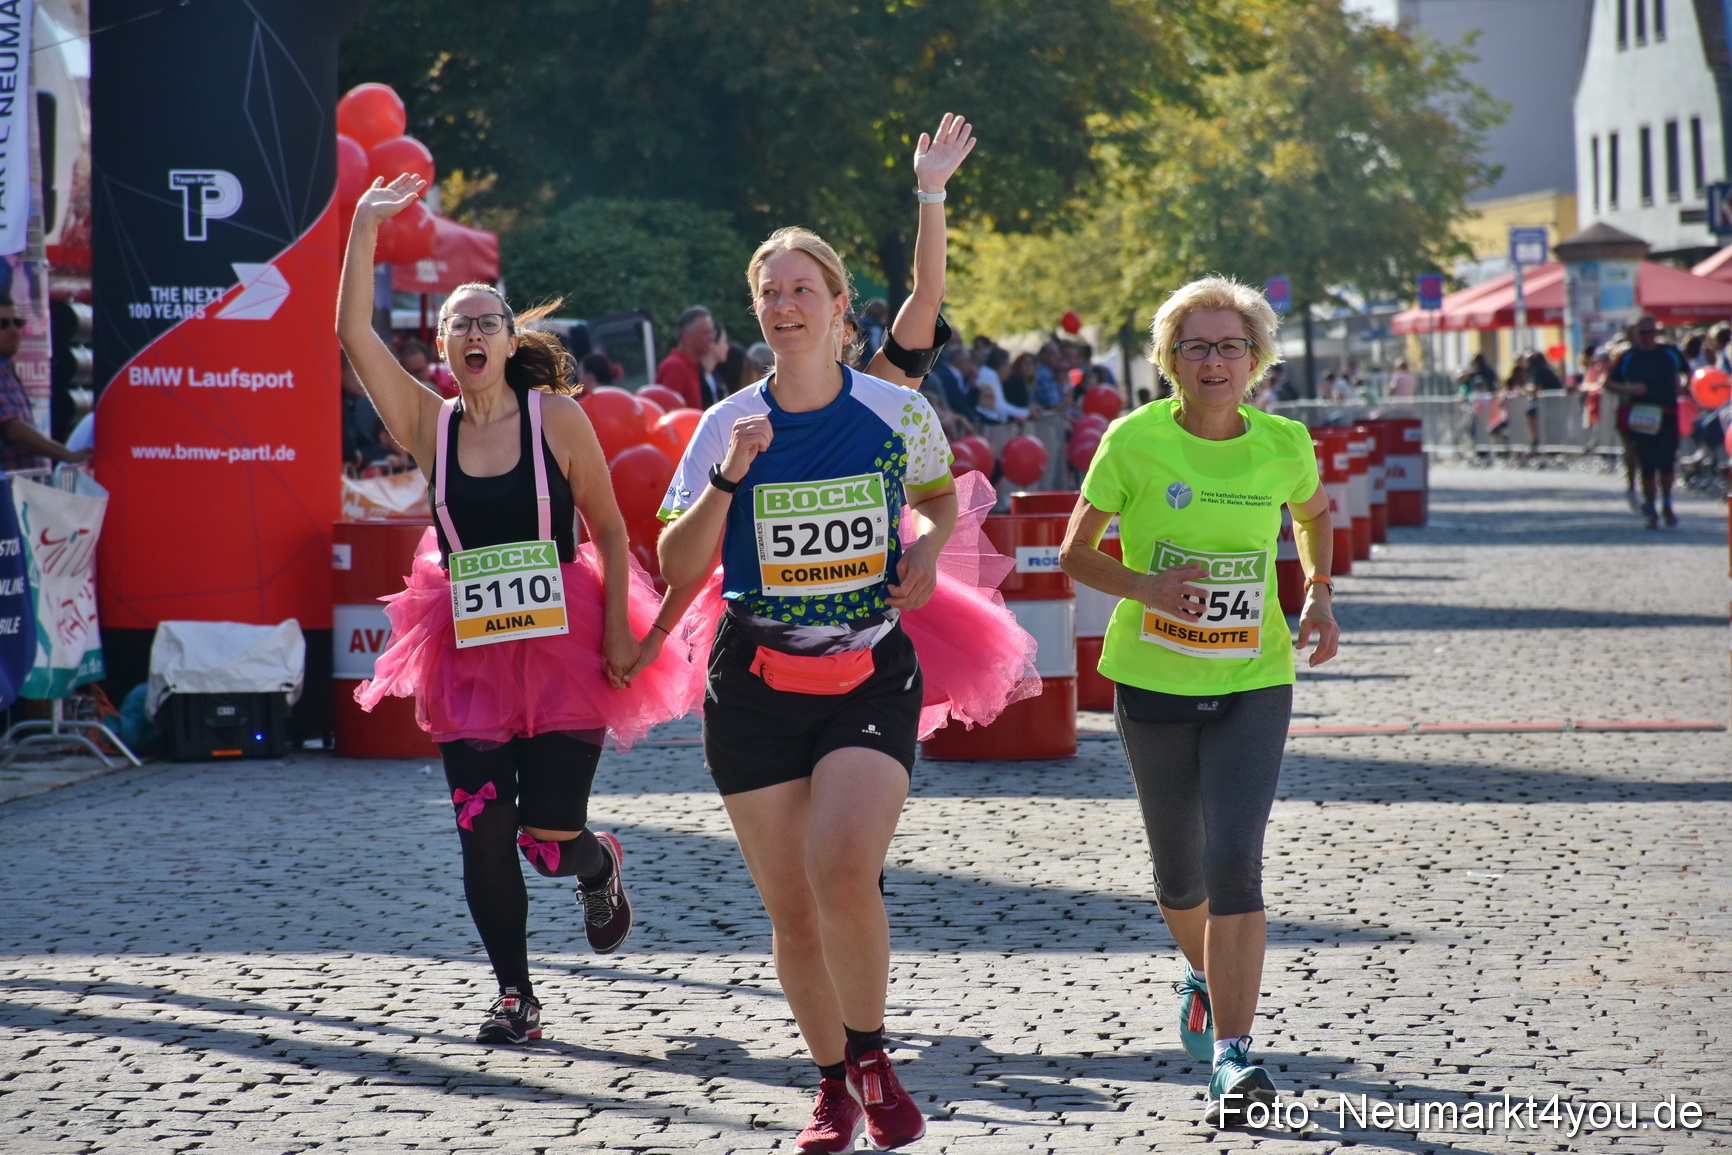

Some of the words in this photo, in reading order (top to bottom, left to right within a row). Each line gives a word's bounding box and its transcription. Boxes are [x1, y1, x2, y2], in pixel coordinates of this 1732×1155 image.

[150, 286, 181, 303] THE
[183, 287, 226, 303] NEXT
[128, 302, 152, 319] 100
[154, 303, 206, 320] YEARS
[129, 366, 183, 387] BMW
[187, 367, 294, 392] Laufsport
[131, 443, 296, 464] www.bmw-partl.de
[763, 479, 876, 514] BOCK
[1215, 491, 1247, 499] katholische
[772, 516, 873, 557] 5209
[457, 545, 551, 578] BOCK
[781, 561, 869, 582] CORINNA
[465, 575, 551, 612] 5110
[1181, 590, 1249, 622] 054
[485, 614, 536, 633] ALINA
[1155, 618, 1249, 644] LIESELOTTE
